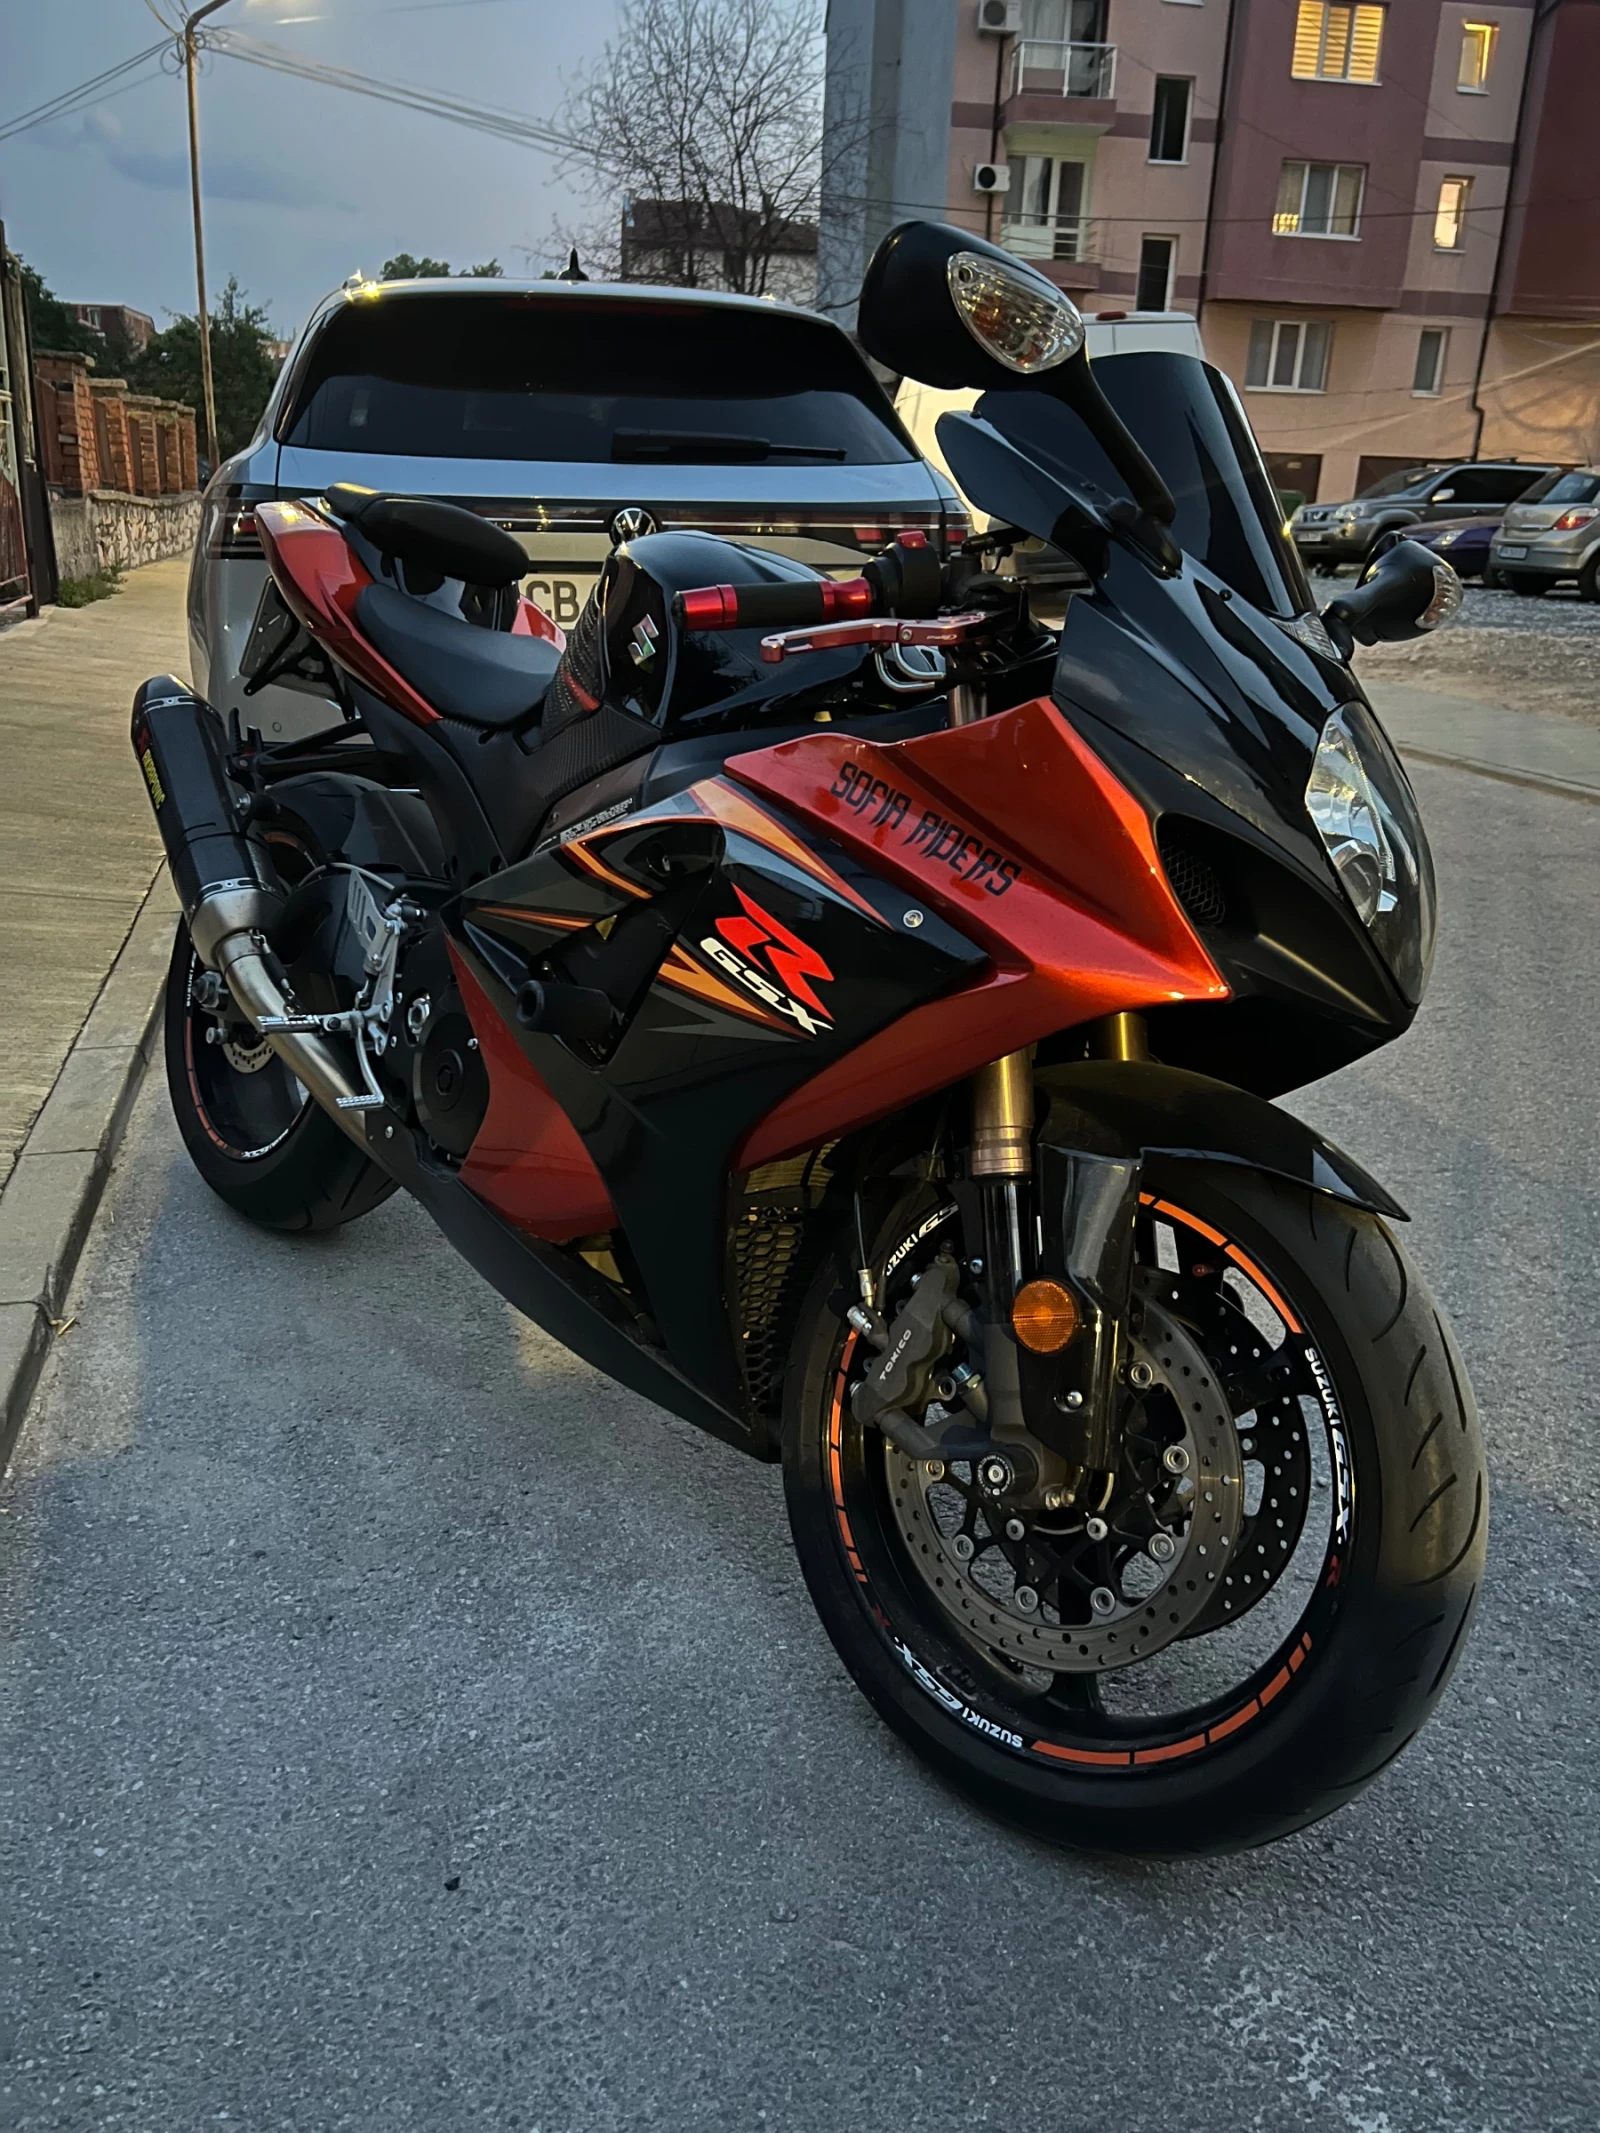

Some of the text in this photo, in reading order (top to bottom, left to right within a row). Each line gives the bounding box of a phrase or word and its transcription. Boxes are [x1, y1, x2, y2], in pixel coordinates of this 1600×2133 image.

[830, 761, 1022, 896] SOFIA RIDERS
[700, 937, 834, 1035] GSX
[879, 1329, 912, 1381] TOKICO
[1304, 1347, 1341, 1426] SUZUKI
[961, 1707, 1024, 1748] SUZUKI
